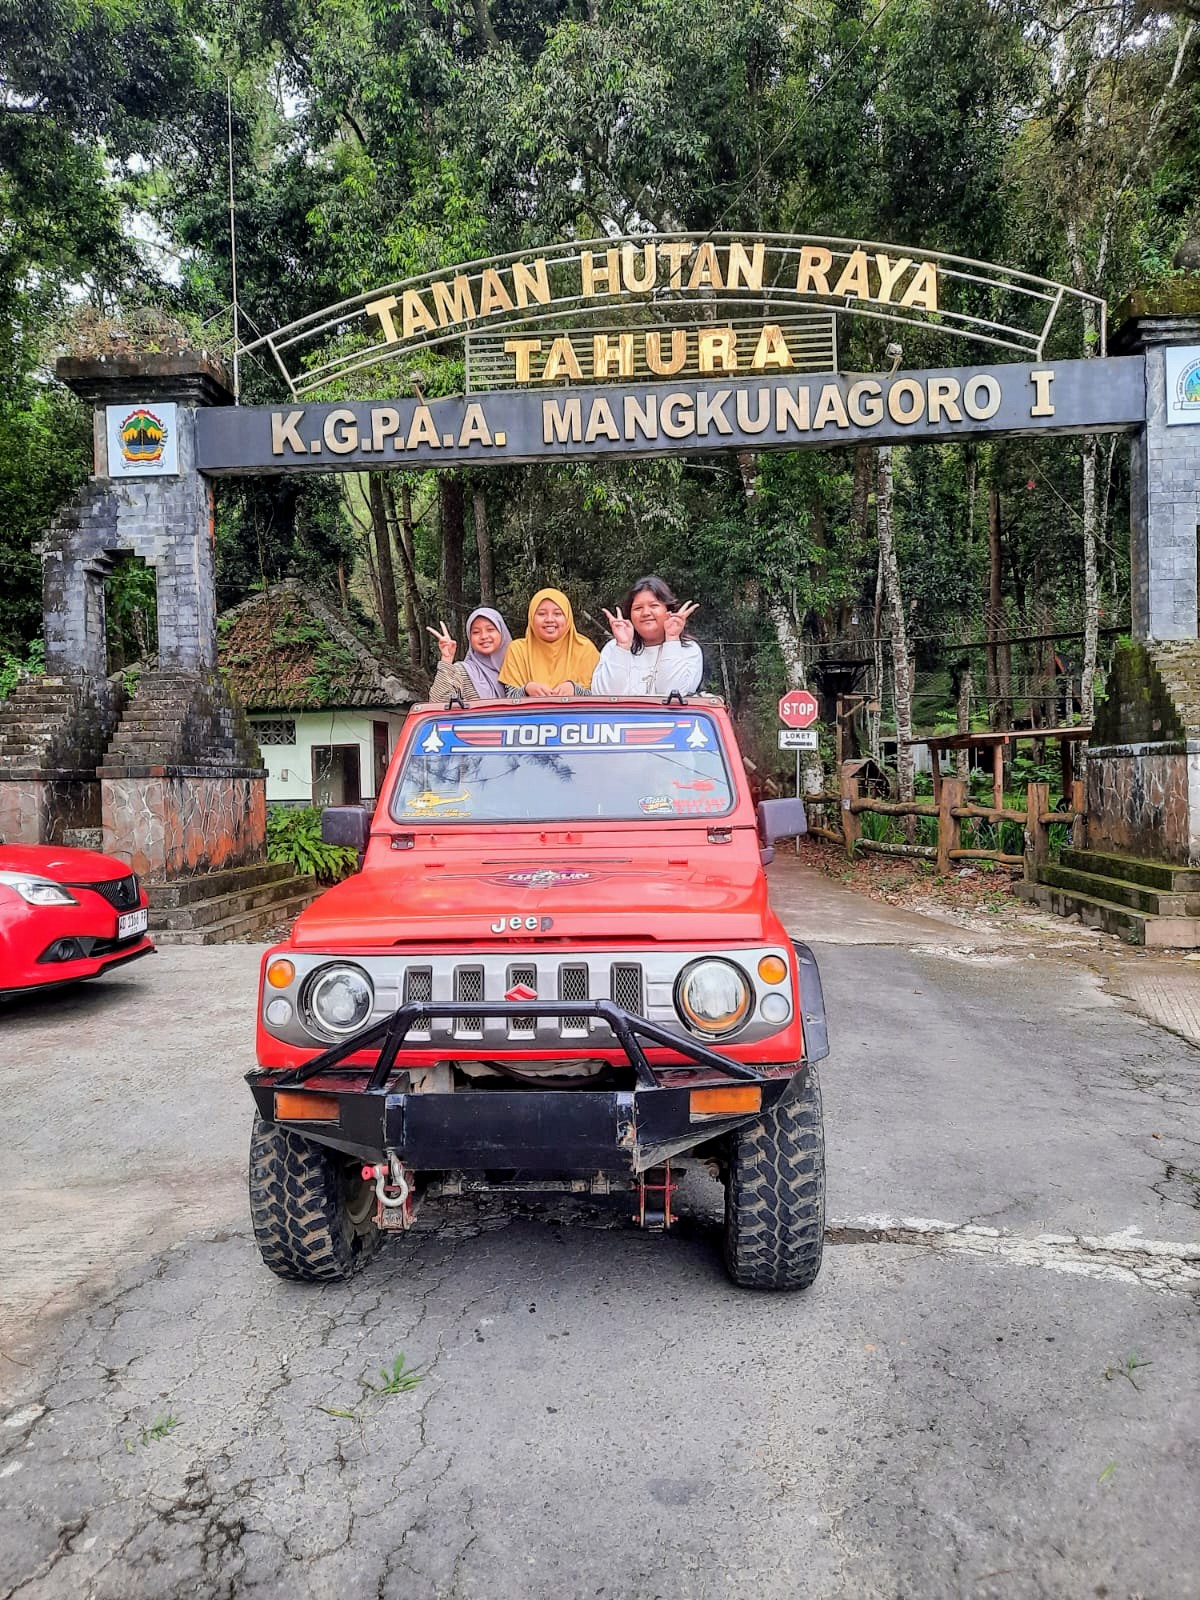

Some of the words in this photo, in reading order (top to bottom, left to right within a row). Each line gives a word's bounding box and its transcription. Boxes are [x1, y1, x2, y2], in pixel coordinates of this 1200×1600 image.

[365, 258, 552, 344] TAMAN
[581, 242, 765, 298] HUTAN
[797, 246, 938, 312] RAYA
[504, 325, 794, 383] TAHURA
[271, 403, 507, 455] K.G.P.A.A.
[542, 374, 1002, 445] MANGKUNAGORO
[1030, 370, 1056, 417] I
[504, 723, 559, 746] TOP
[560, 723, 621, 745] GUN
[783, 702, 814, 716] STOP
